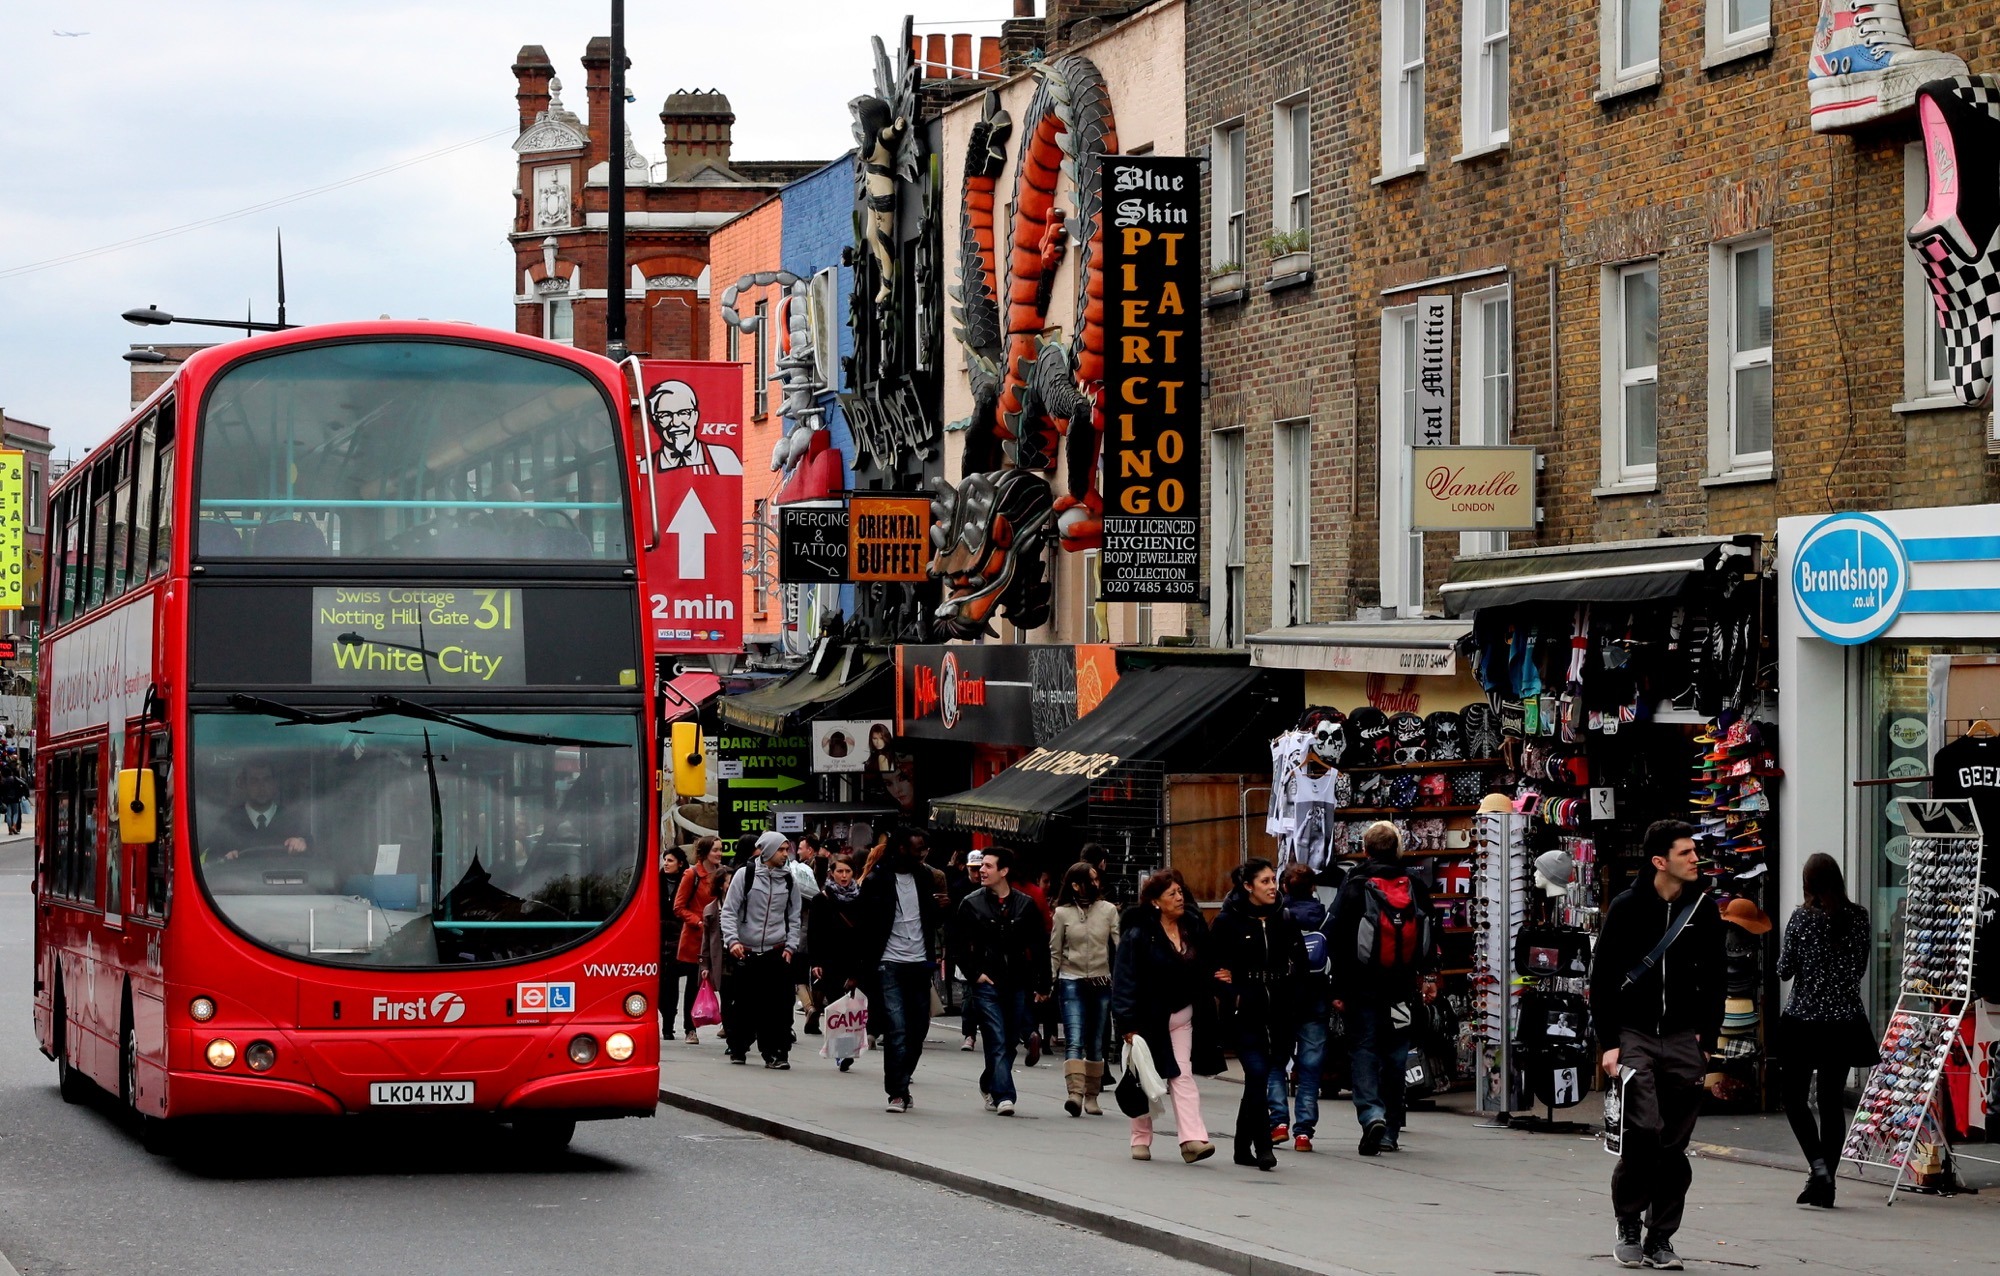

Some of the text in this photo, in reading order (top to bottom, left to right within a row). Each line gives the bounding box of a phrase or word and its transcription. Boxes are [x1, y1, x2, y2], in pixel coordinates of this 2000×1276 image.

[1114, 165, 1184, 192] Blue
[1114, 198, 1188, 227] Skin
[1421, 304, 1445, 398] Militia
[1119, 227, 1153, 514] PIERCING
[1157, 232, 1185, 513] TATTOO
[701, 422, 739, 436] KFC
[1421, 405, 1443, 445] tal
[1425, 465, 1521, 501] Vanilla
[1451, 502, 1496, 512] LONDON
[786, 512, 850, 528] PIERCING
[858, 514, 922, 540] ORIENTAL
[1103, 519, 1196, 534] FULLY LICENCED
[10, 491, 21, 593] TATTOO
[814, 530, 825, 543] &
[1106, 536, 1196, 551] HYGIENIC
[792, 542, 848, 558] TATTOO
[857, 543, 922, 574] BUFFET
[1104, 552, 1198, 566] BODY JEWELLERY
[1116, 567, 1187, 580] COLLECTION
[1802, 550, 1889, 600] Brandshop
[336, 588, 455, 608] Swiss Cottage
[1106, 581, 1195, 594] 020 7485 4305
[472, 589, 512, 630] 31
[651, 593, 734, 620] 2 min
[1852, 592, 1876, 609] .co.uk
[320, 608, 470, 630] Notting Hill Gate
[332, 642, 503, 681] White City
[720, 737, 760, 749] DARK
[768, 736, 812, 748] ANGE
[739, 755, 798, 768] TATTOO
[583, 962, 659, 978] VNW32400
[372, 995, 427, 1021] First
[378, 1084, 467, 1103] LK04 HXJ
